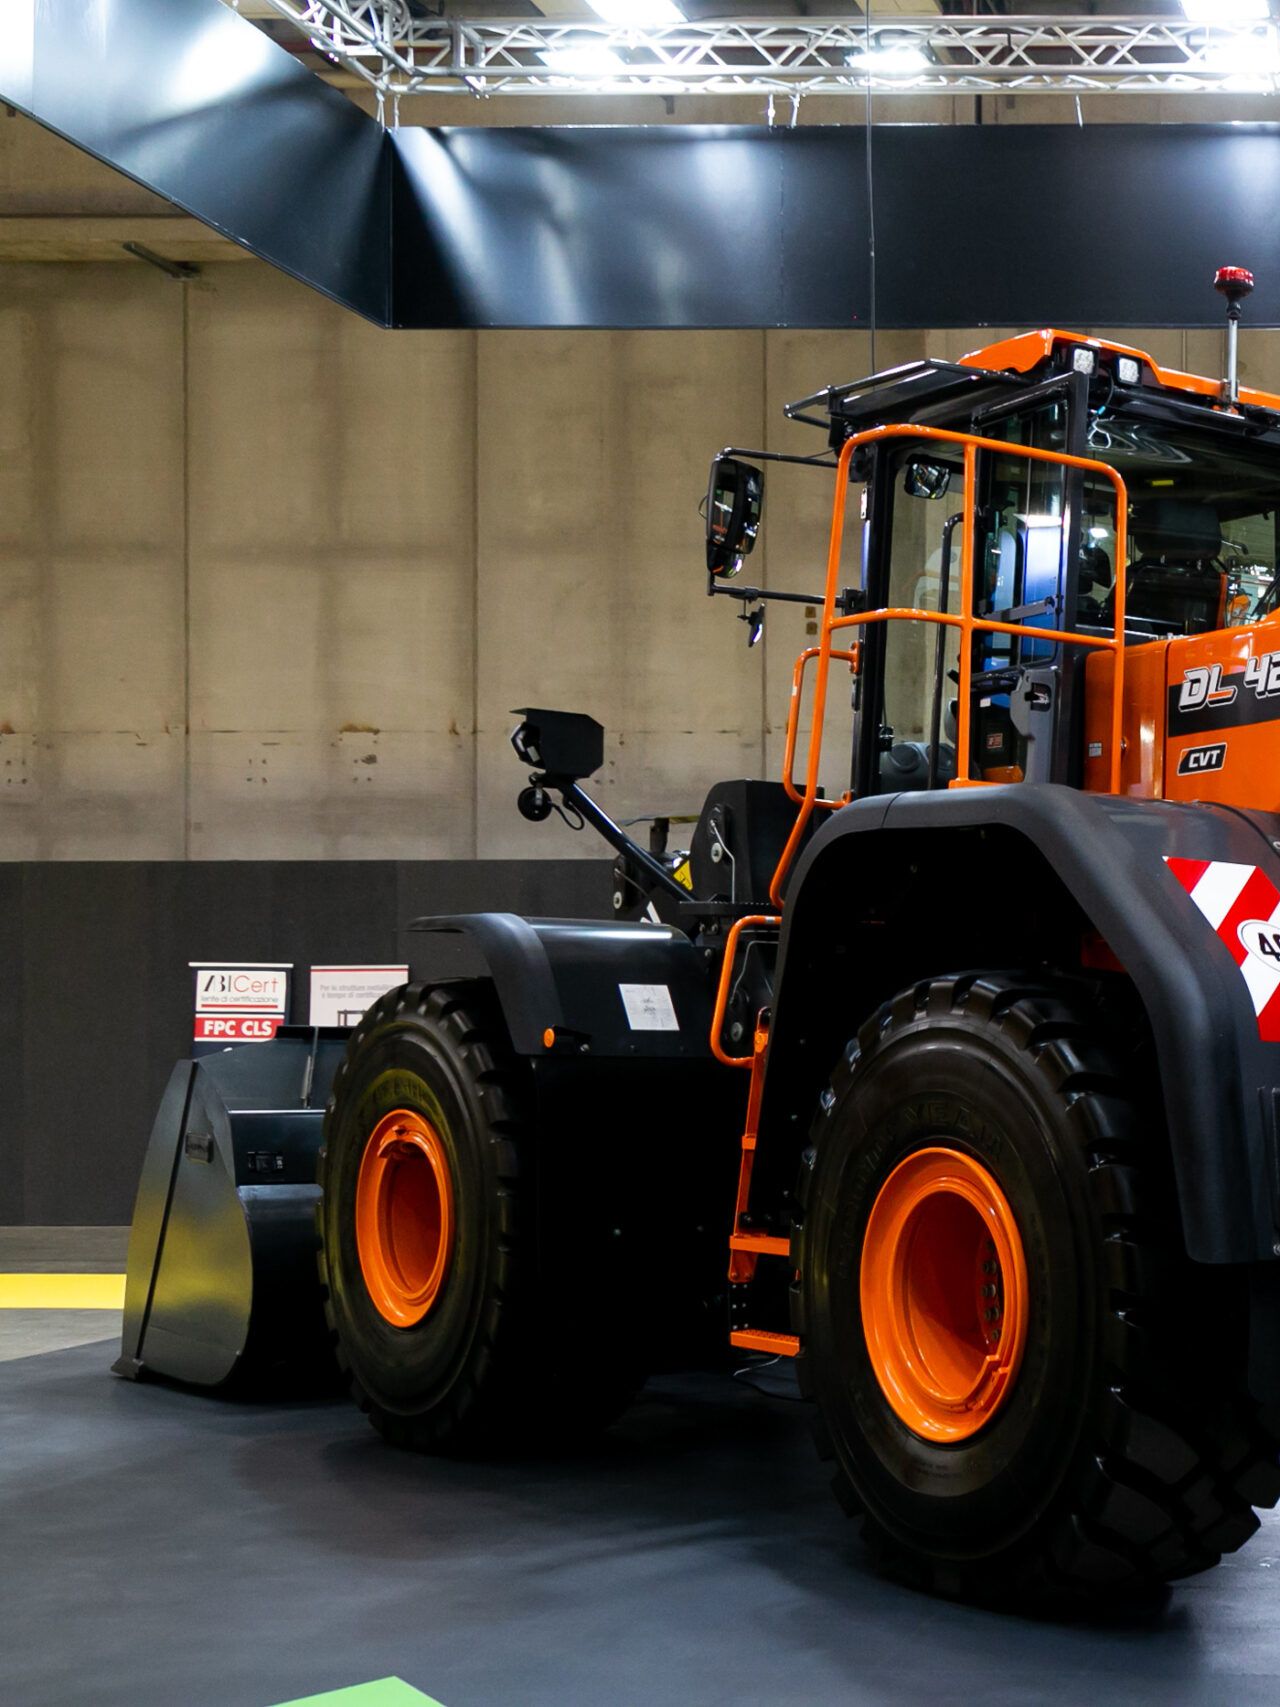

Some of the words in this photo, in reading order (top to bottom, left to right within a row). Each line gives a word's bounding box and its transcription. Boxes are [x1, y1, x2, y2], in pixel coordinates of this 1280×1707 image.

[1178, 663, 1238, 712] DL
[1188, 750, 1221, 769] CVT
[203, 1020, 237, 1036] FPC
[241, 1020, 272, 1036] CLS
